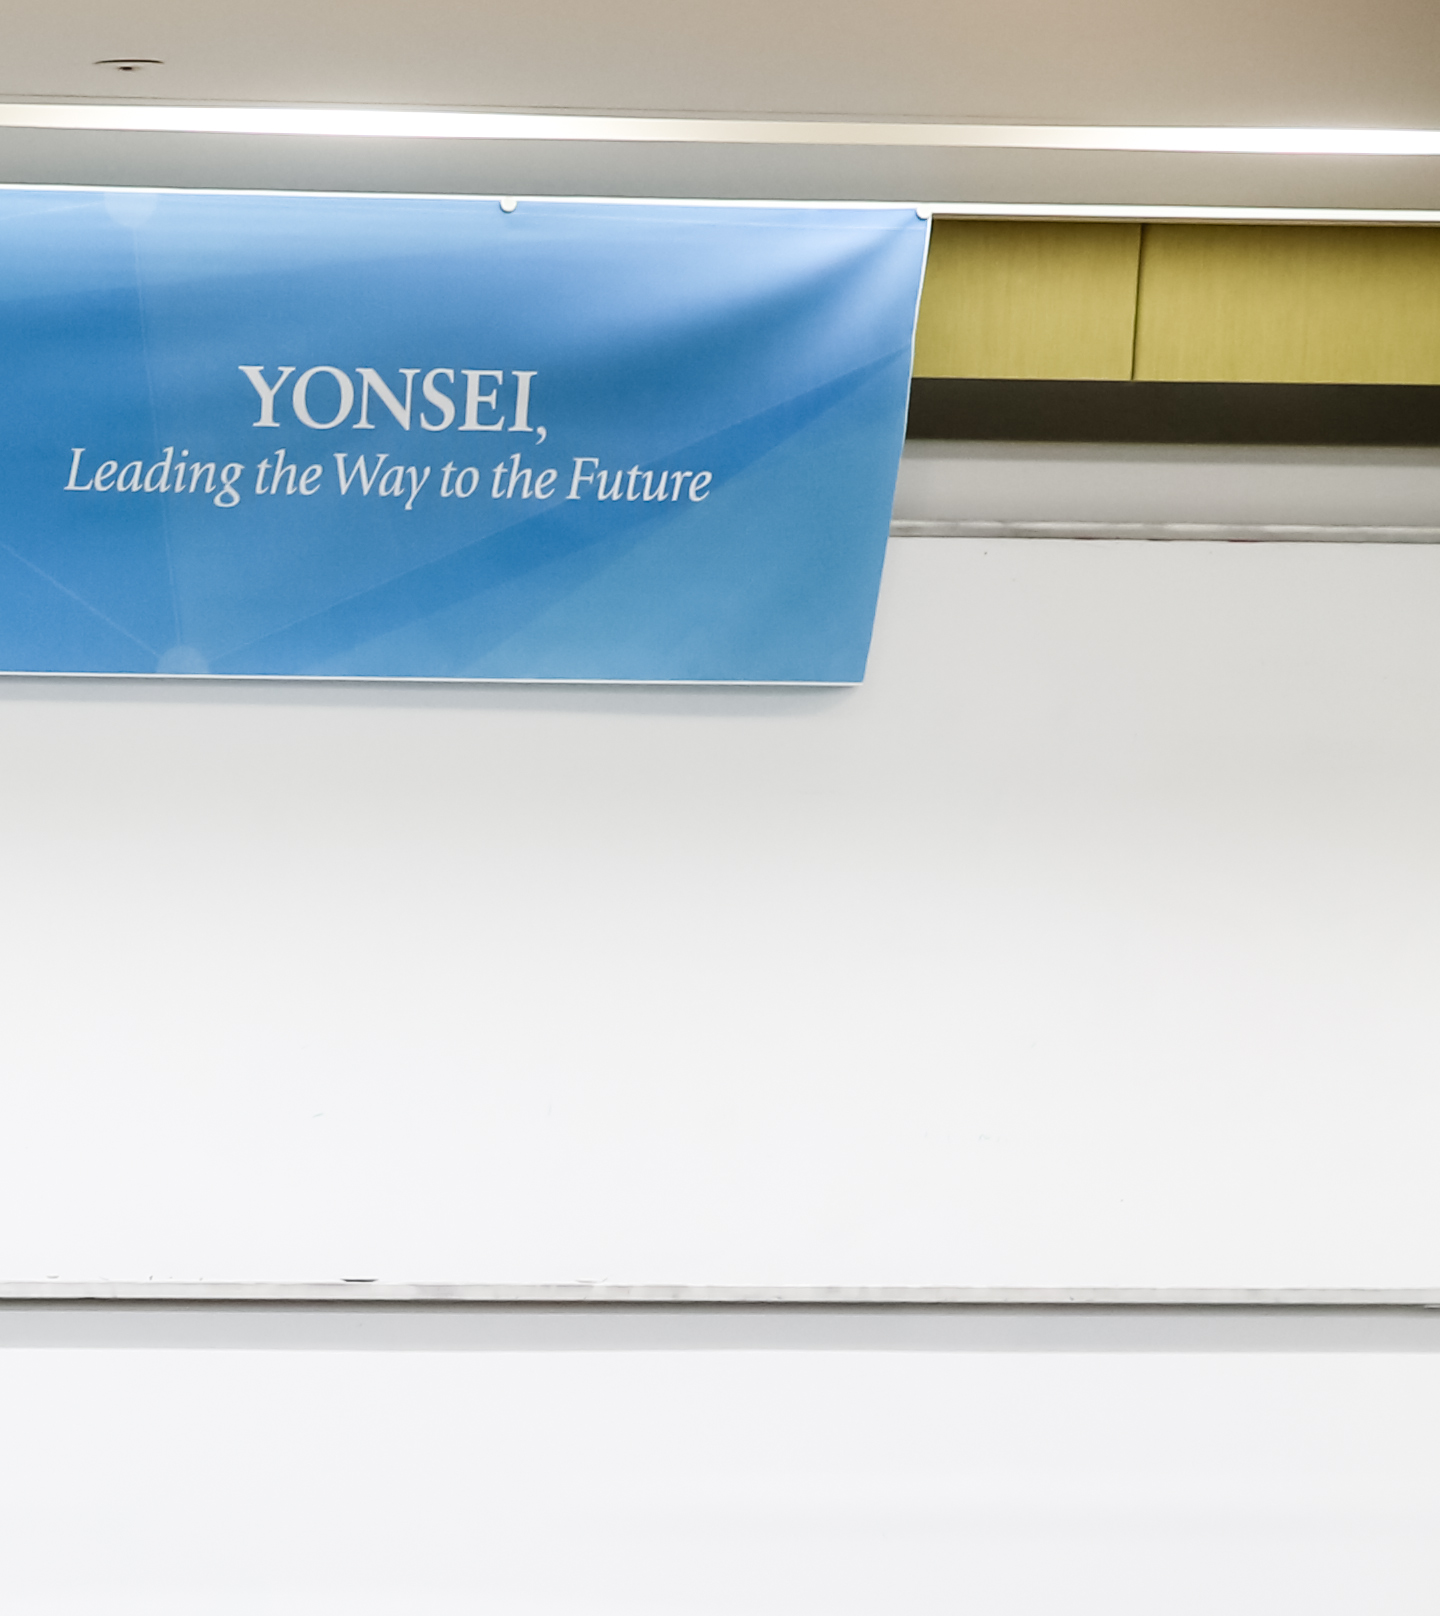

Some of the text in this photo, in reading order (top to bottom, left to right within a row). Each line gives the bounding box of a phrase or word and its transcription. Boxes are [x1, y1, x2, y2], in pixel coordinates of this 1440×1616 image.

[239, 365, 549, 445] YONSEI,
[64, 447, 714, 511] Leading the Way to the Future
